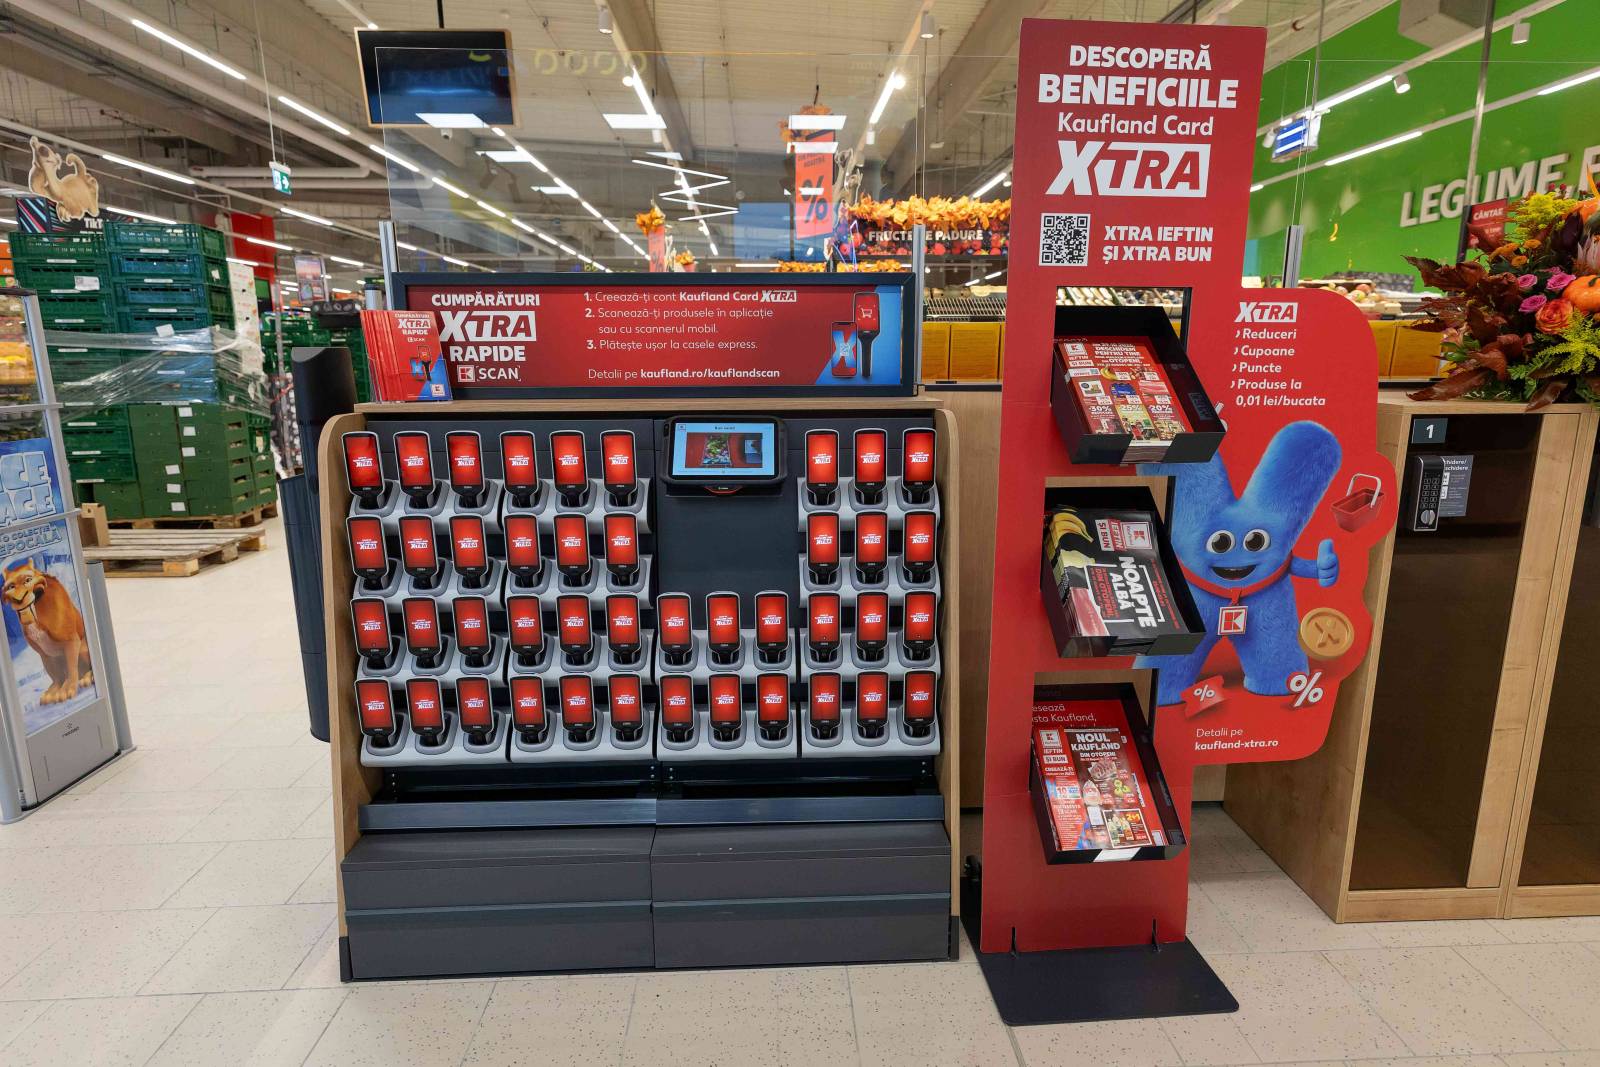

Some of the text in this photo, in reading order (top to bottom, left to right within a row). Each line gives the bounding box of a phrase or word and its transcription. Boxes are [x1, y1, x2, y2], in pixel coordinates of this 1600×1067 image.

[1069, 43, 1212, 71] DESCOPERĂ
[1038, 73, 1239, 109] BENEFICIILE
[1058, 111, 1214, 136] Kaufland Card
[1045, 140, 1211, 198] XTRA
[1104, 226, 1213, 242] XTRA IEFTIN
[1102, 246, 1212, 265] ȘI XTRA BUN
[431, 289, 540, 307] CUMPĂRĂTURI
[583, 290, 797, 304] 1. Creează-ți cont Kaufland Card XTRA
[585, 307, 774, 321] 2. Scanează-ți produsele în aplicație
[1235, 301, 1298, 323] XTRA
[440, 310, 537, 342] XTRA
[598, 323, 718, 334] sau cu scannerul mobil.
[1242, 328, 1297, 340] Reduceri
[587, 339, 758, 352] 3. Plătește ușor la casele express.
[1240, 345, 1295, 358] Cupoane
[450, 345, 527, 362] RAPIDE
[478, 367, 519, 380] SCAN
[588, 368, 780, 381] Detalii pe kaufland.ro/kauflandscan
[1239, 361, 1282, 374] Puncte
[1237, 378, 1302, 391] Produse la
[1236, 395, 1261, 408] 0,01
[1426, 424, 1435, 439] 1
[1100, 531, 1112, 549] BUN
[1109, 572, 1136, 610] ALBĂ
[1119, 556, 1157, 628] NOAPTE
[1075, 732, 1111, 743] NOUL
[1196, 728, 1243, 738] Detalii pe
[1070, 742, 1121, 751] KAUFLAND
[1195, 739, 1279, 751] kaufland-xtra.ro
